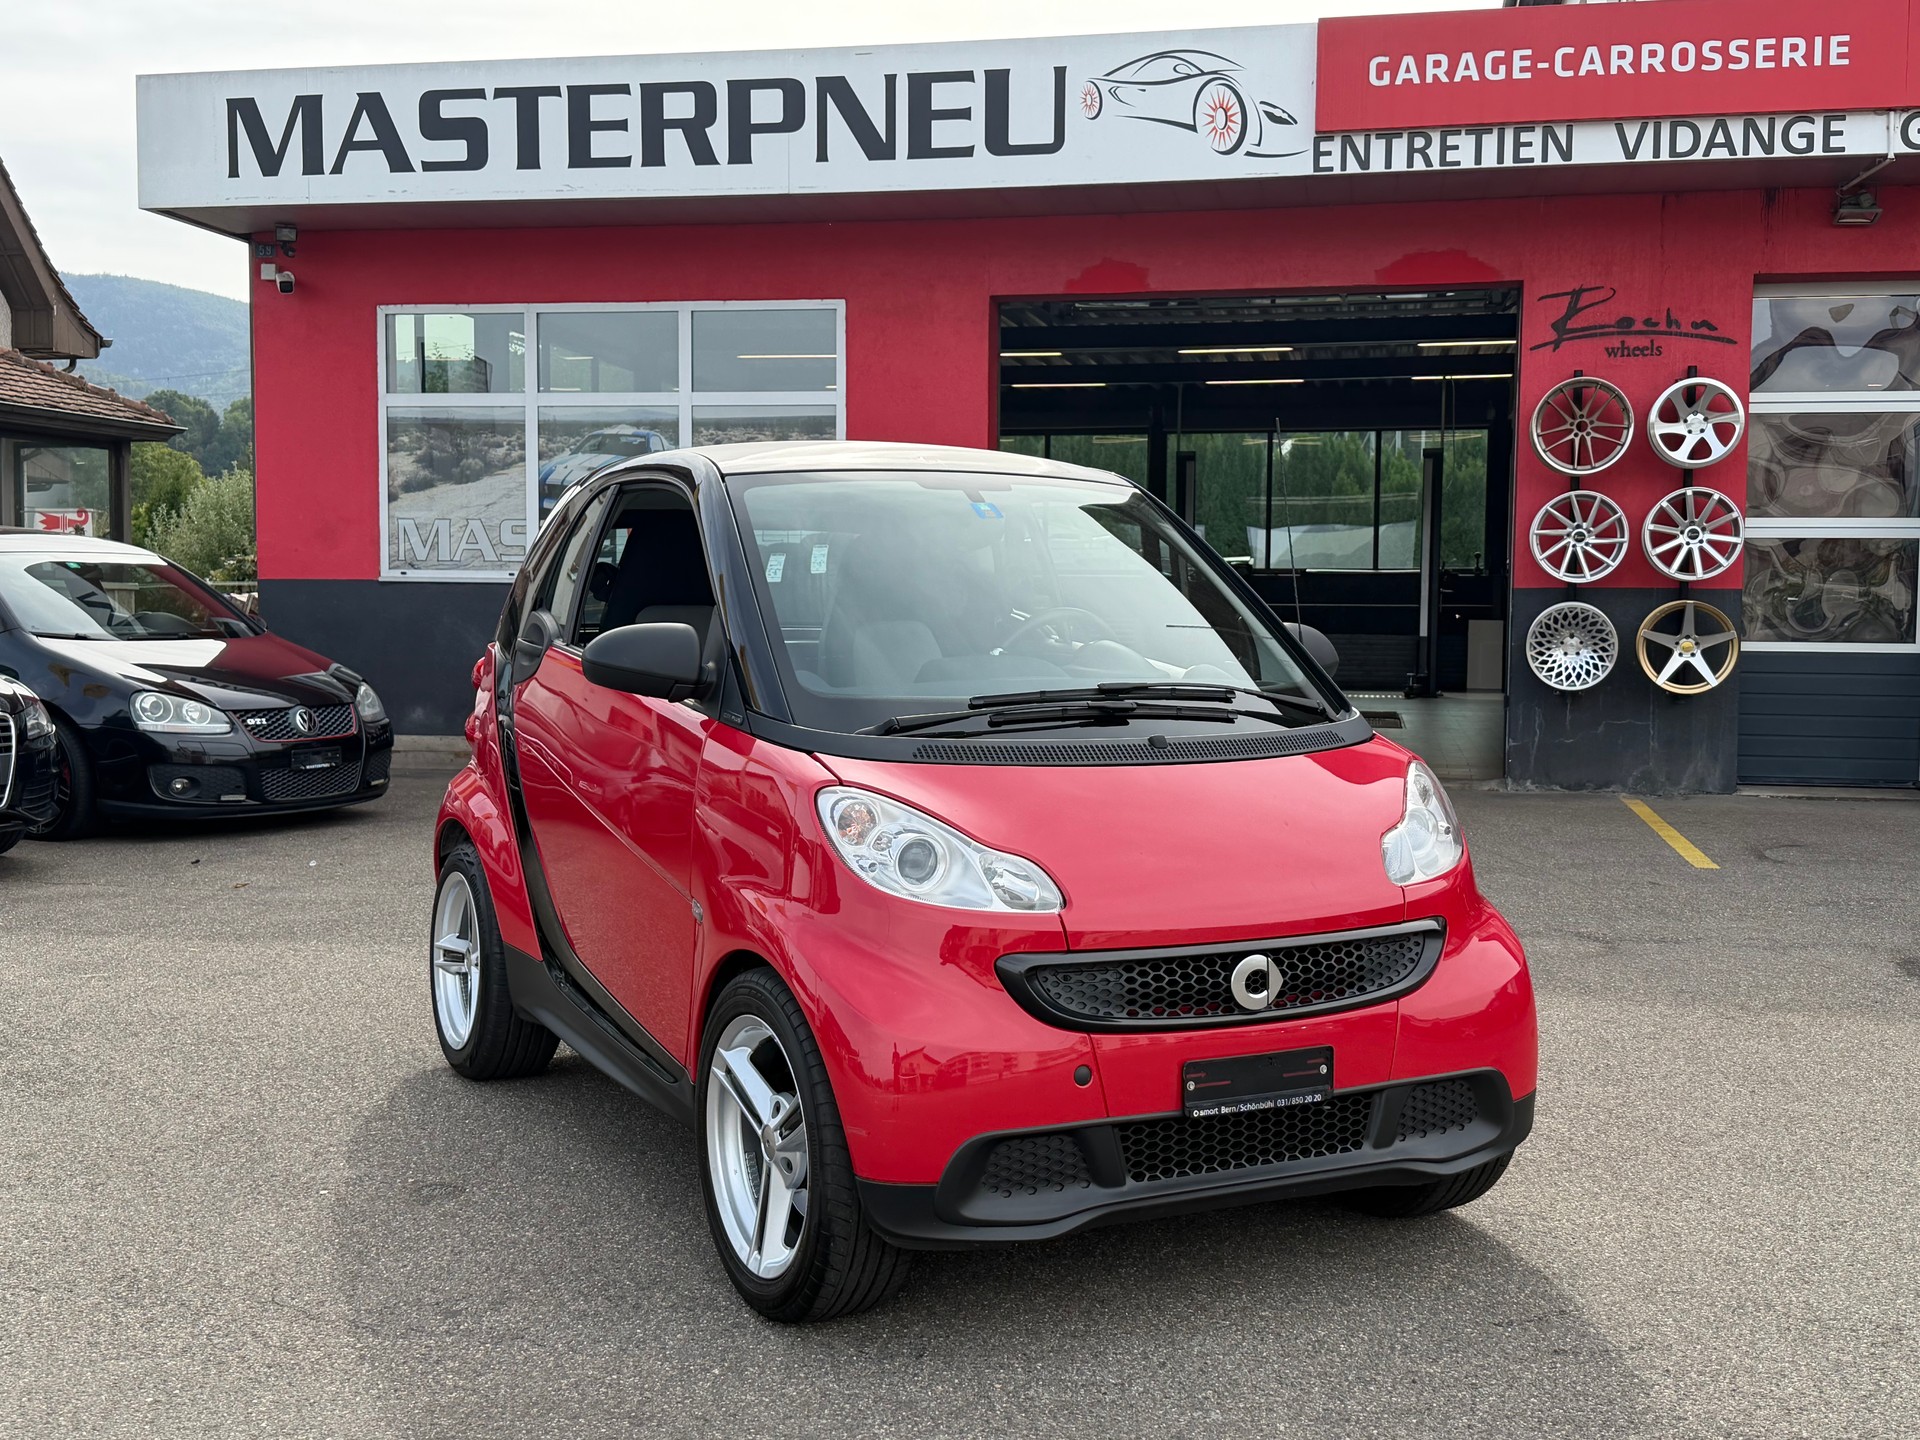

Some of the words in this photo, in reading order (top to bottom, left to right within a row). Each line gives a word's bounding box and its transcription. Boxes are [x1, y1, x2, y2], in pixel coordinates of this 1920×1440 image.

[1368, 34, 1851, 87] GARAGE-CARROSSERIE
[225, 66, 1068, 178] MASTERPNEU
[1312, 124, 1575, 173] ENTRETIEN
[1614, 115, 1847, 160] VIDANGE
[1604, 339, 1663, 358] wheels
[246, 717, 267, 725] GTI
[1220, 1101, 1275, 1114] Bern/Schönbühl
[1276, 1096, 1304, 1107] 031/850
